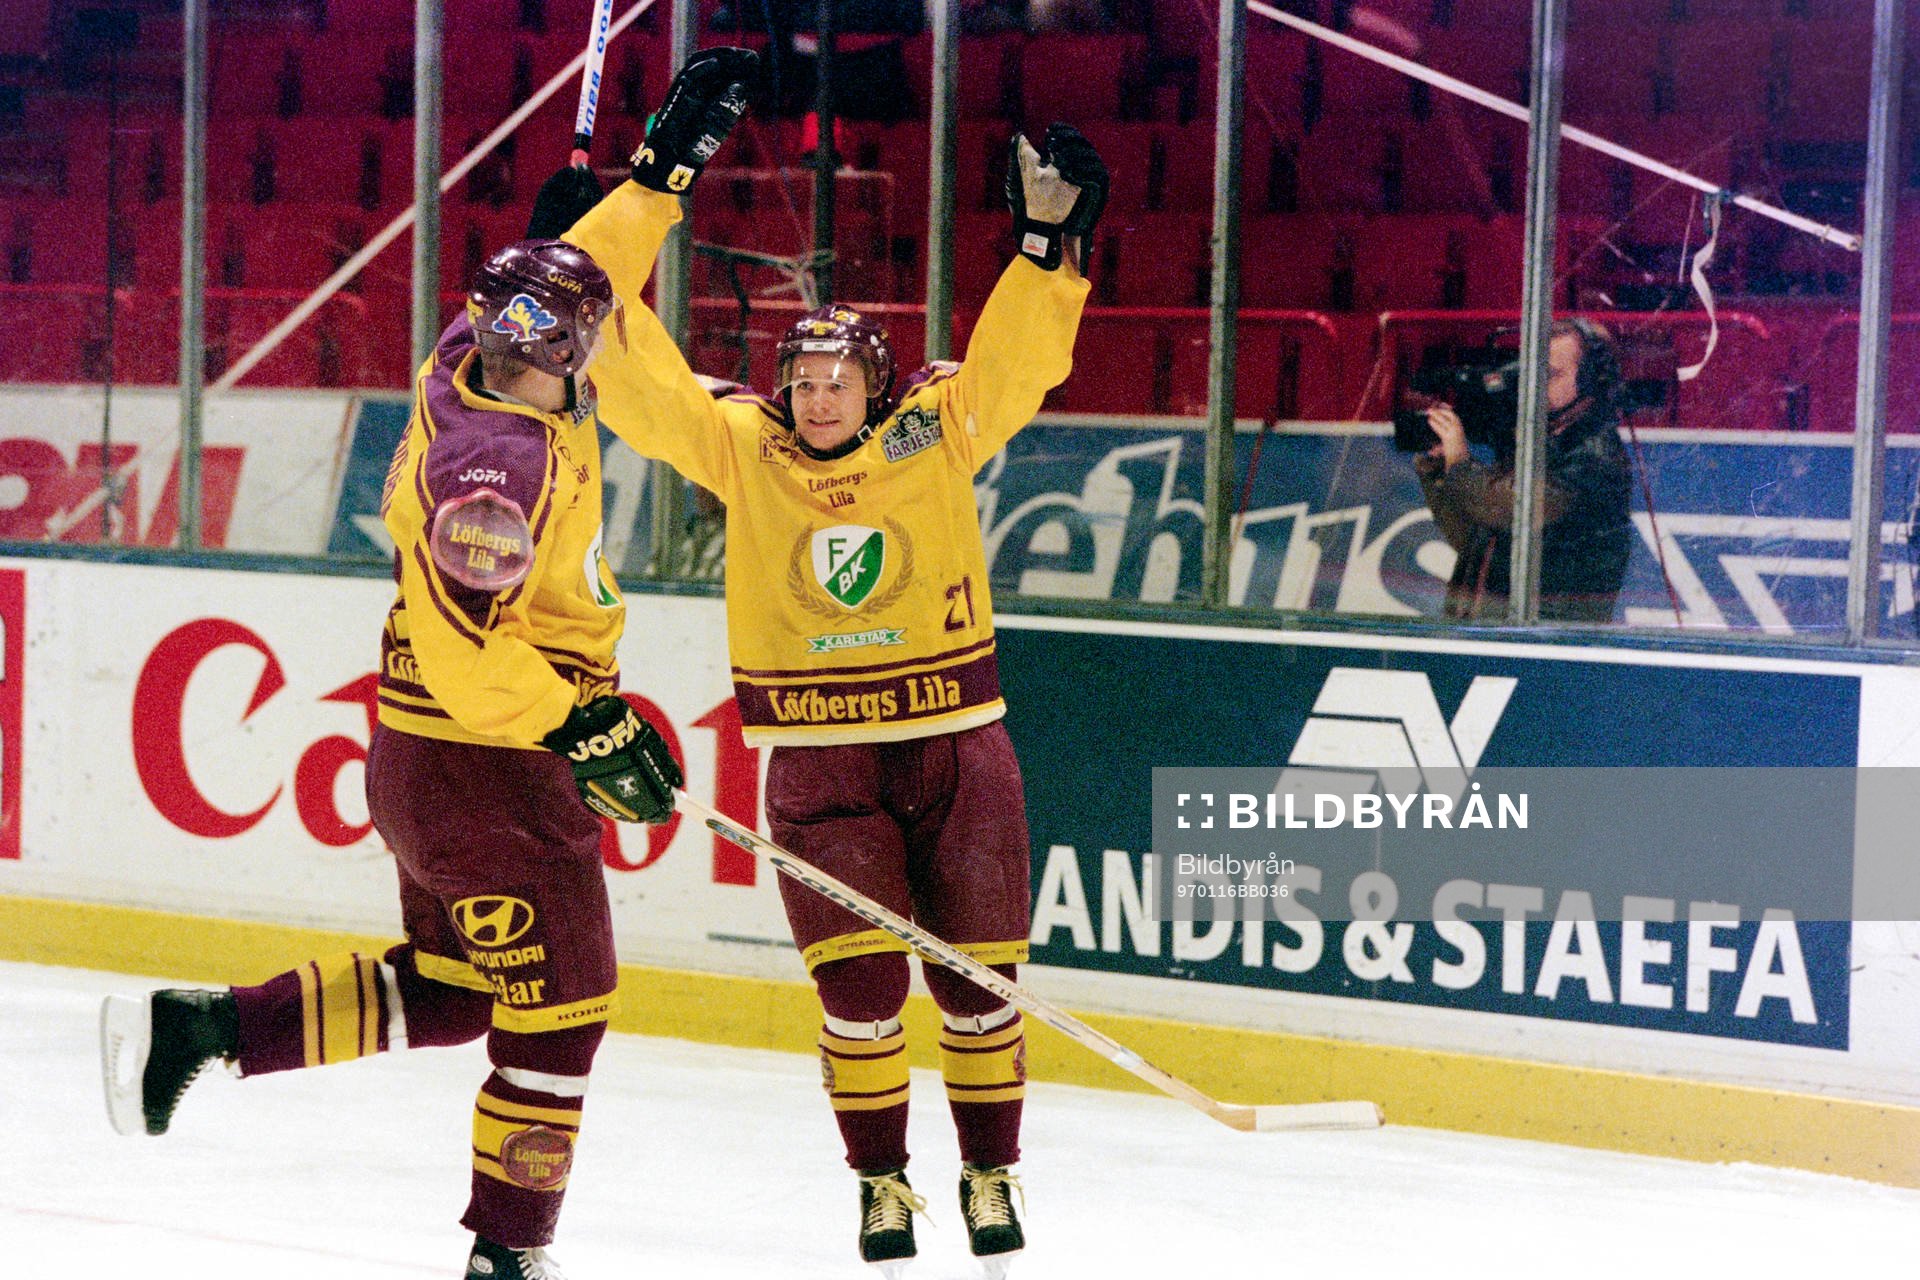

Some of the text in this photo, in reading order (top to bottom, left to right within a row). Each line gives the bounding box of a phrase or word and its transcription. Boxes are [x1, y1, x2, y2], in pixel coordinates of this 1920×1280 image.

[459, 468, 507, 485] JOFA
[808, 469, 868, 494] Löfbergs
[829, 491, 856, 508] Lila
[451, 522, 521, 557] Löfbergs
[467, 549, 496, 572] Lila
[943, 574, 976, 634] 21
[825, 629, 888, 648] KARLSTAD
[767, 674, 961, 723] Löfbergs Lila
[568, 706, 642, 762] JOFA
[768, 857, 976, 978] Canadien
[1029, 843, 1326, 975] ANDIS
[1343, 870, 1416, 985] &
[1430, 876, 1819, 1026] STAEFA
[468, 944, 546, 969] HYUNDAI
[490, 973, 546, 1005] ilar
[514, 1148, 567, 1166] Löfbergs
[528, 1164, 552, 1178] Lila
